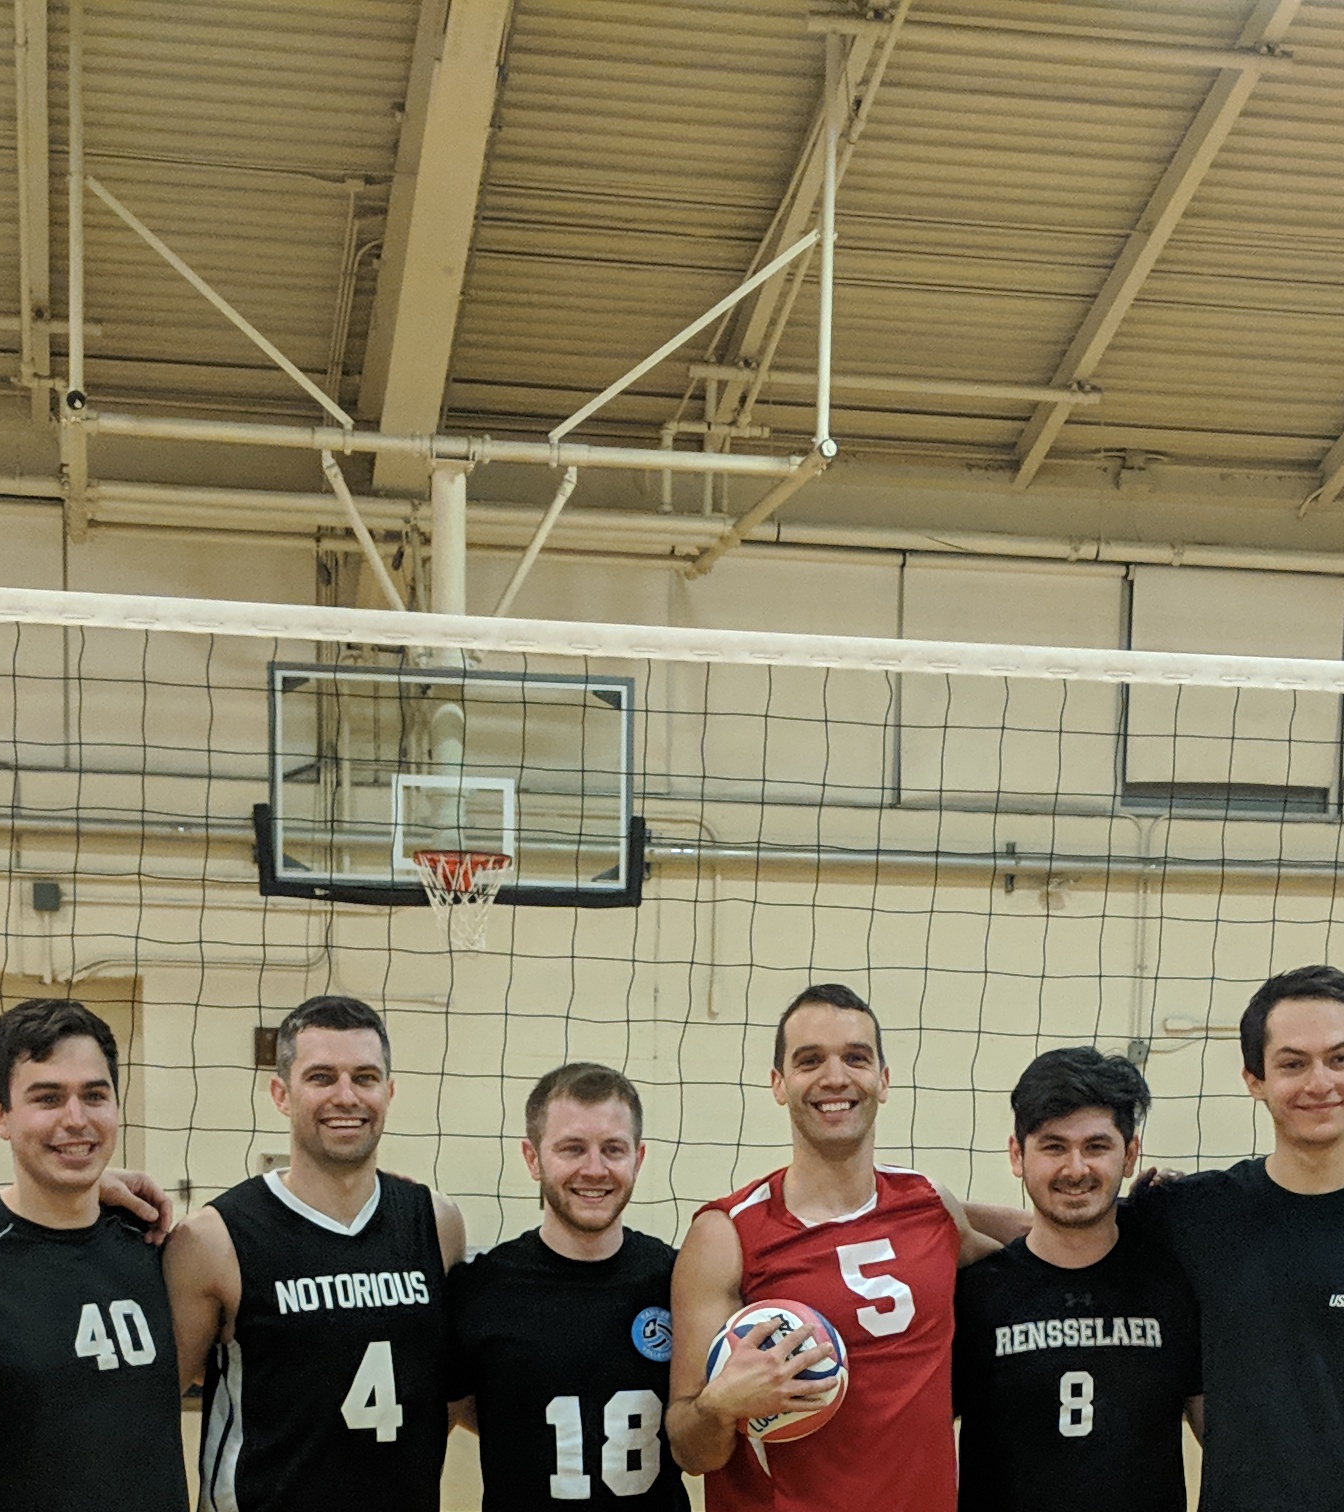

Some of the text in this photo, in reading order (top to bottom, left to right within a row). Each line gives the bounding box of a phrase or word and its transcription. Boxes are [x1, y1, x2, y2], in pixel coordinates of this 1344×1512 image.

[274, 1270, 430, 1315] NOTORIOUS
[836, 1238, 915, 1338] 5
[74, 1299, 157, 1371] 40
[994, 1316, 1163, 1357] RENSSELAER
[340, 1340, 404, 1443] 4
[1058, 1370, 1095, 1438] 8
[545, 1389, 664, 1500] 18
